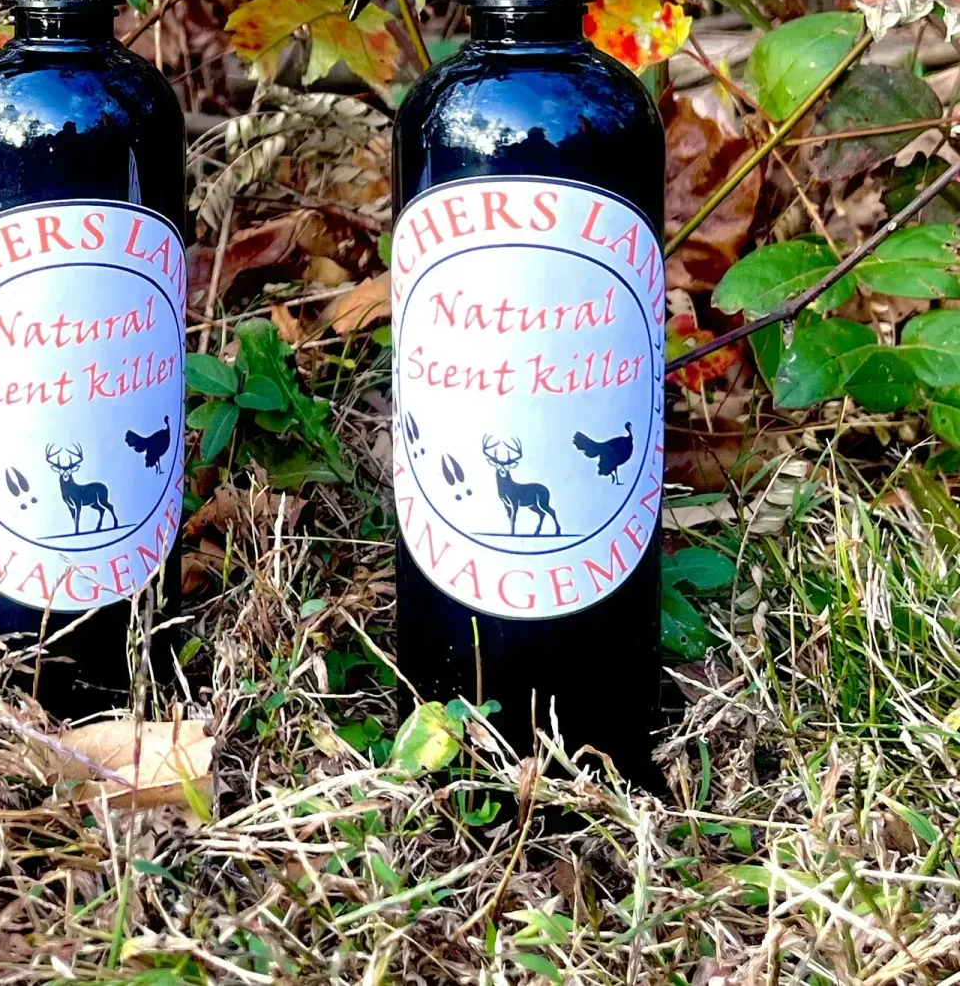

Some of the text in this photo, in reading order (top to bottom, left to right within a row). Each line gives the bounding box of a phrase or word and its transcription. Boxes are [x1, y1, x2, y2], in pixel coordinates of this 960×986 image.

[391, 191, 666, 327] ECHERS LAND
[428, 286, 618, 335] Natural
[82, 352, 178, 402] killer
[406, 345, 646, 397] Scent killer
